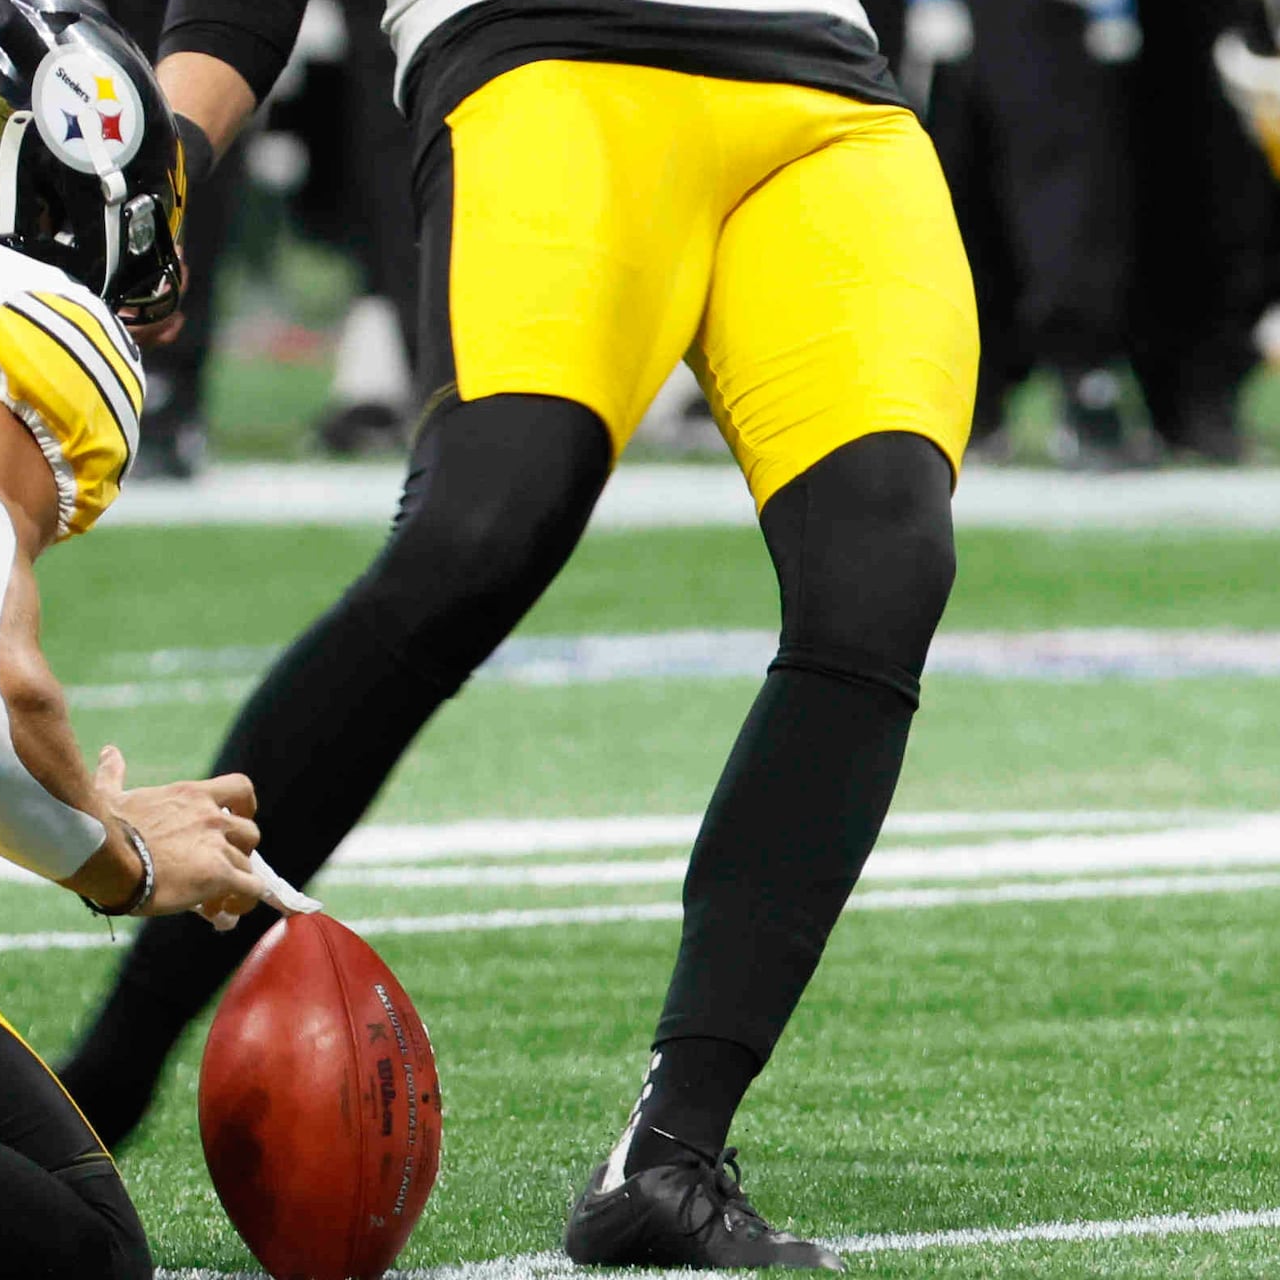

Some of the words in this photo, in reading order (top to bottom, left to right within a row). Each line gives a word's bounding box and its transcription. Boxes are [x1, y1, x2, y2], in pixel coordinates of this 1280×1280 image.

[55, 67, 90, 103] Steelers
[373, 983, 408, 1056] NATIONAL
[403, 1064, 418, 1147] FOOTBALL
[392, 1156, 413, 1216] LEAGUE
